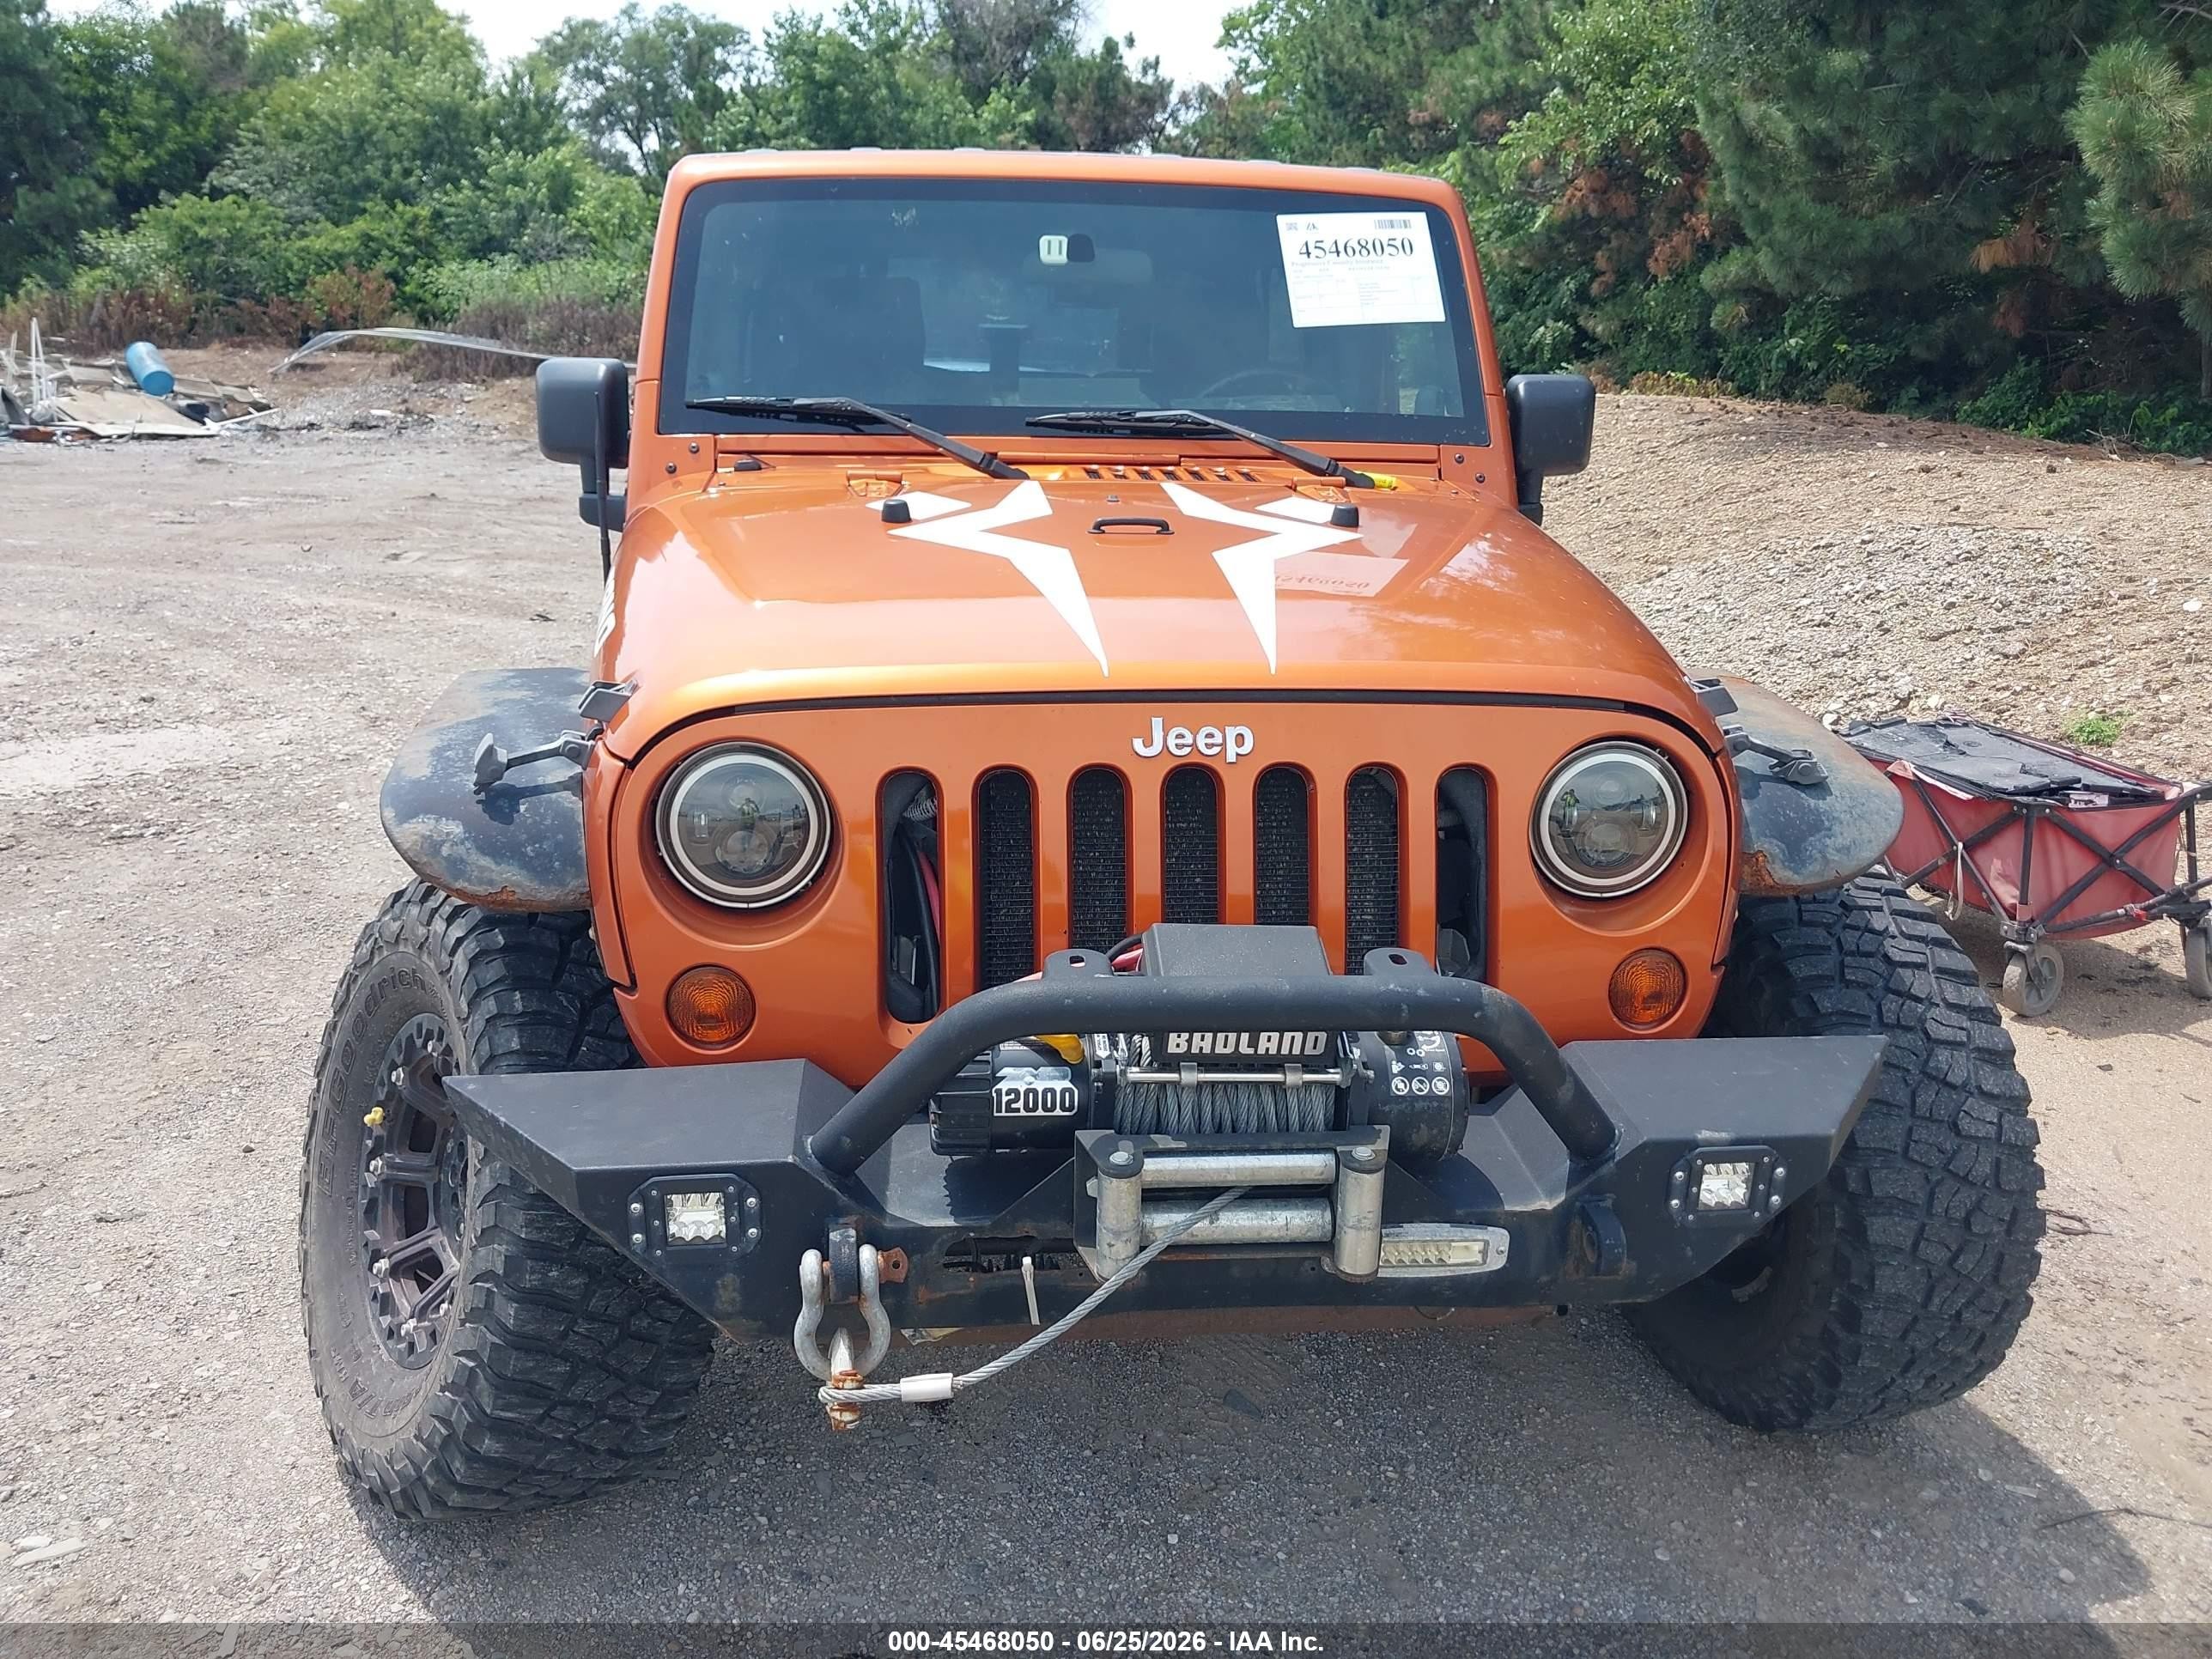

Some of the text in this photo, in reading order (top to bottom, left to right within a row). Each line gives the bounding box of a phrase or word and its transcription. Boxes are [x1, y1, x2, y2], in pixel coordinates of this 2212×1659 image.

[1298, 237, 1414, 259] 45468050
[1132, 716, 1255, 763] Jeep
[1167, 1031, 1328, 1055] BADLAND
[993, 1087, 1078, 1115] 12000
